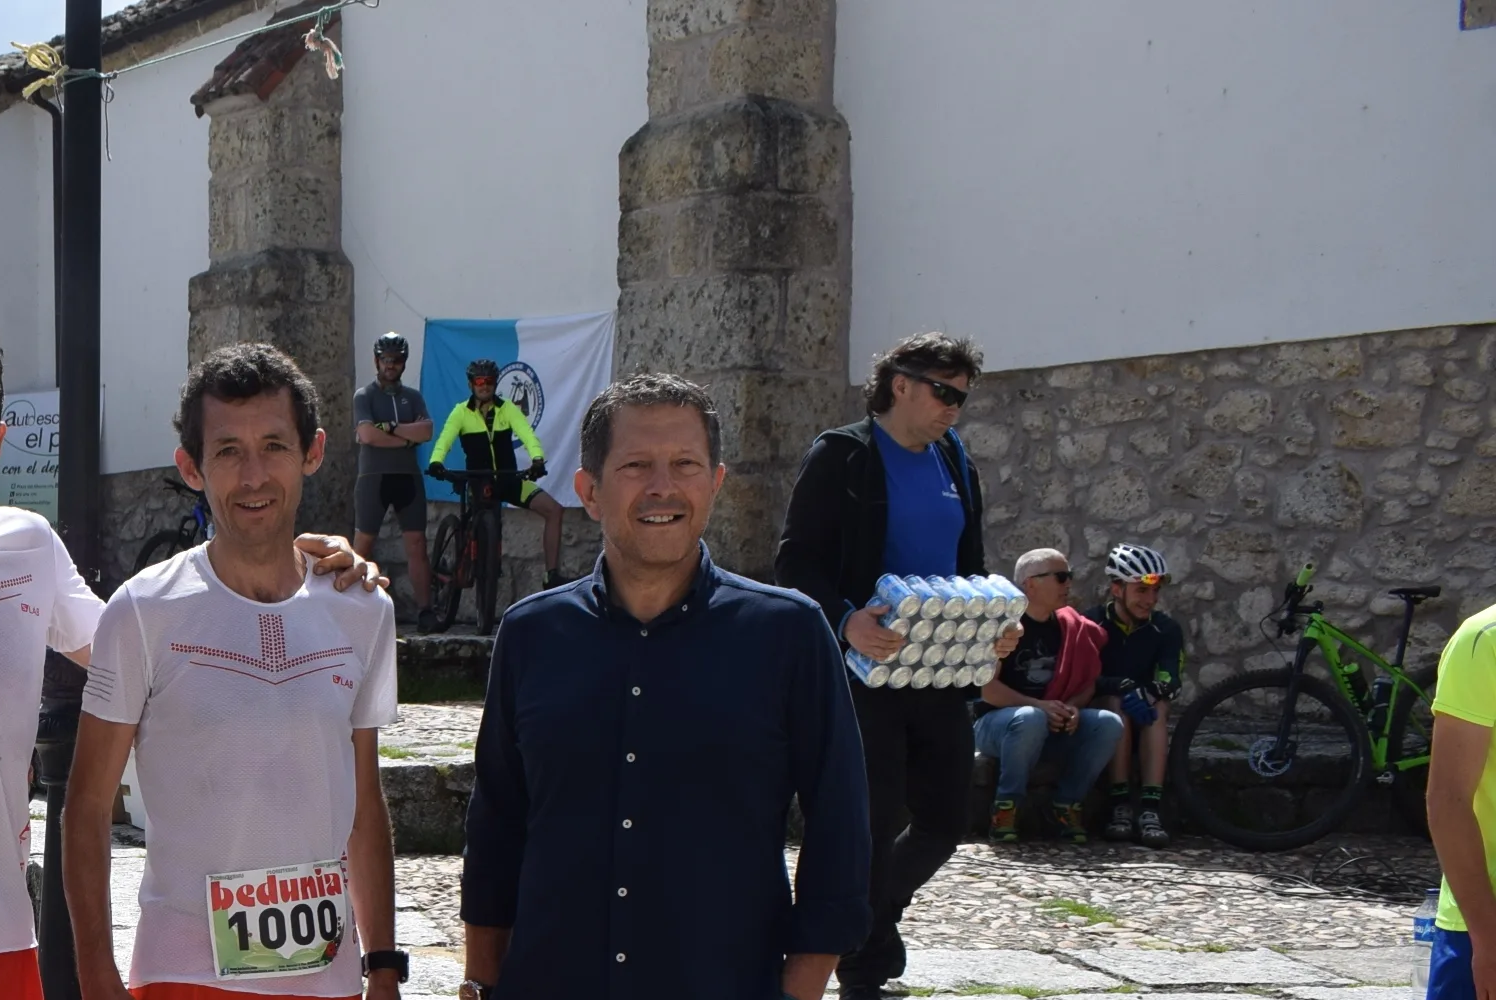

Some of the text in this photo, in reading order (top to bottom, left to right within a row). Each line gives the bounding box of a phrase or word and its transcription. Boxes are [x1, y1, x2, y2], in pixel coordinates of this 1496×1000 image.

[26, 428, 43, 449] el
[2, 464, 22, 475] con
[26, 461, 37, 475] el
[210, 868, 343, 912] bedunia
[228, 899, 338, 951] 1000
